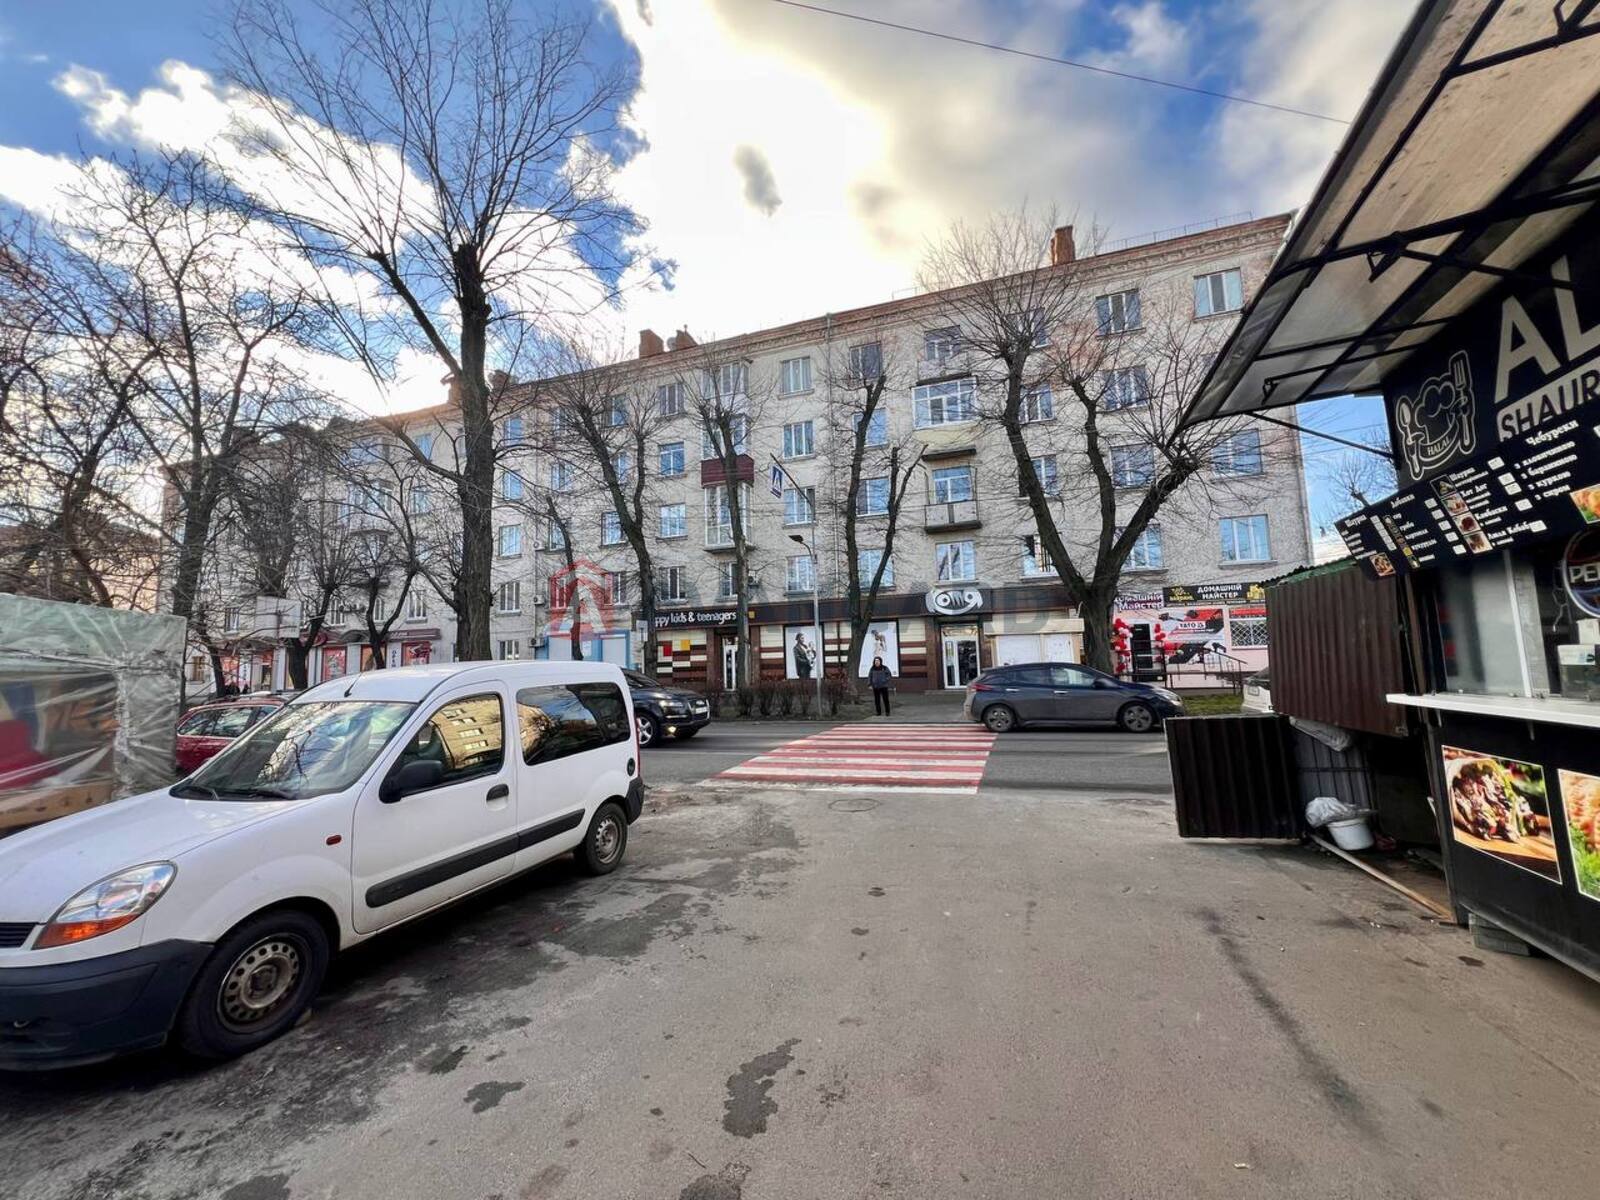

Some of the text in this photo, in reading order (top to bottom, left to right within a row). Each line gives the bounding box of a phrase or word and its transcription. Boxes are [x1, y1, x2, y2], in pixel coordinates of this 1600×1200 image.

[1525, 419, 1579, 446] Чебуреки
[1427, 437, 1451, 456] HALAL
[1197, 584, 1242, 593] ДОМАШНІЙ
[1202, 592, 1239, 600] МАЙСТЕР
[655, 611, 736, 627] ppy kids & teenagers
